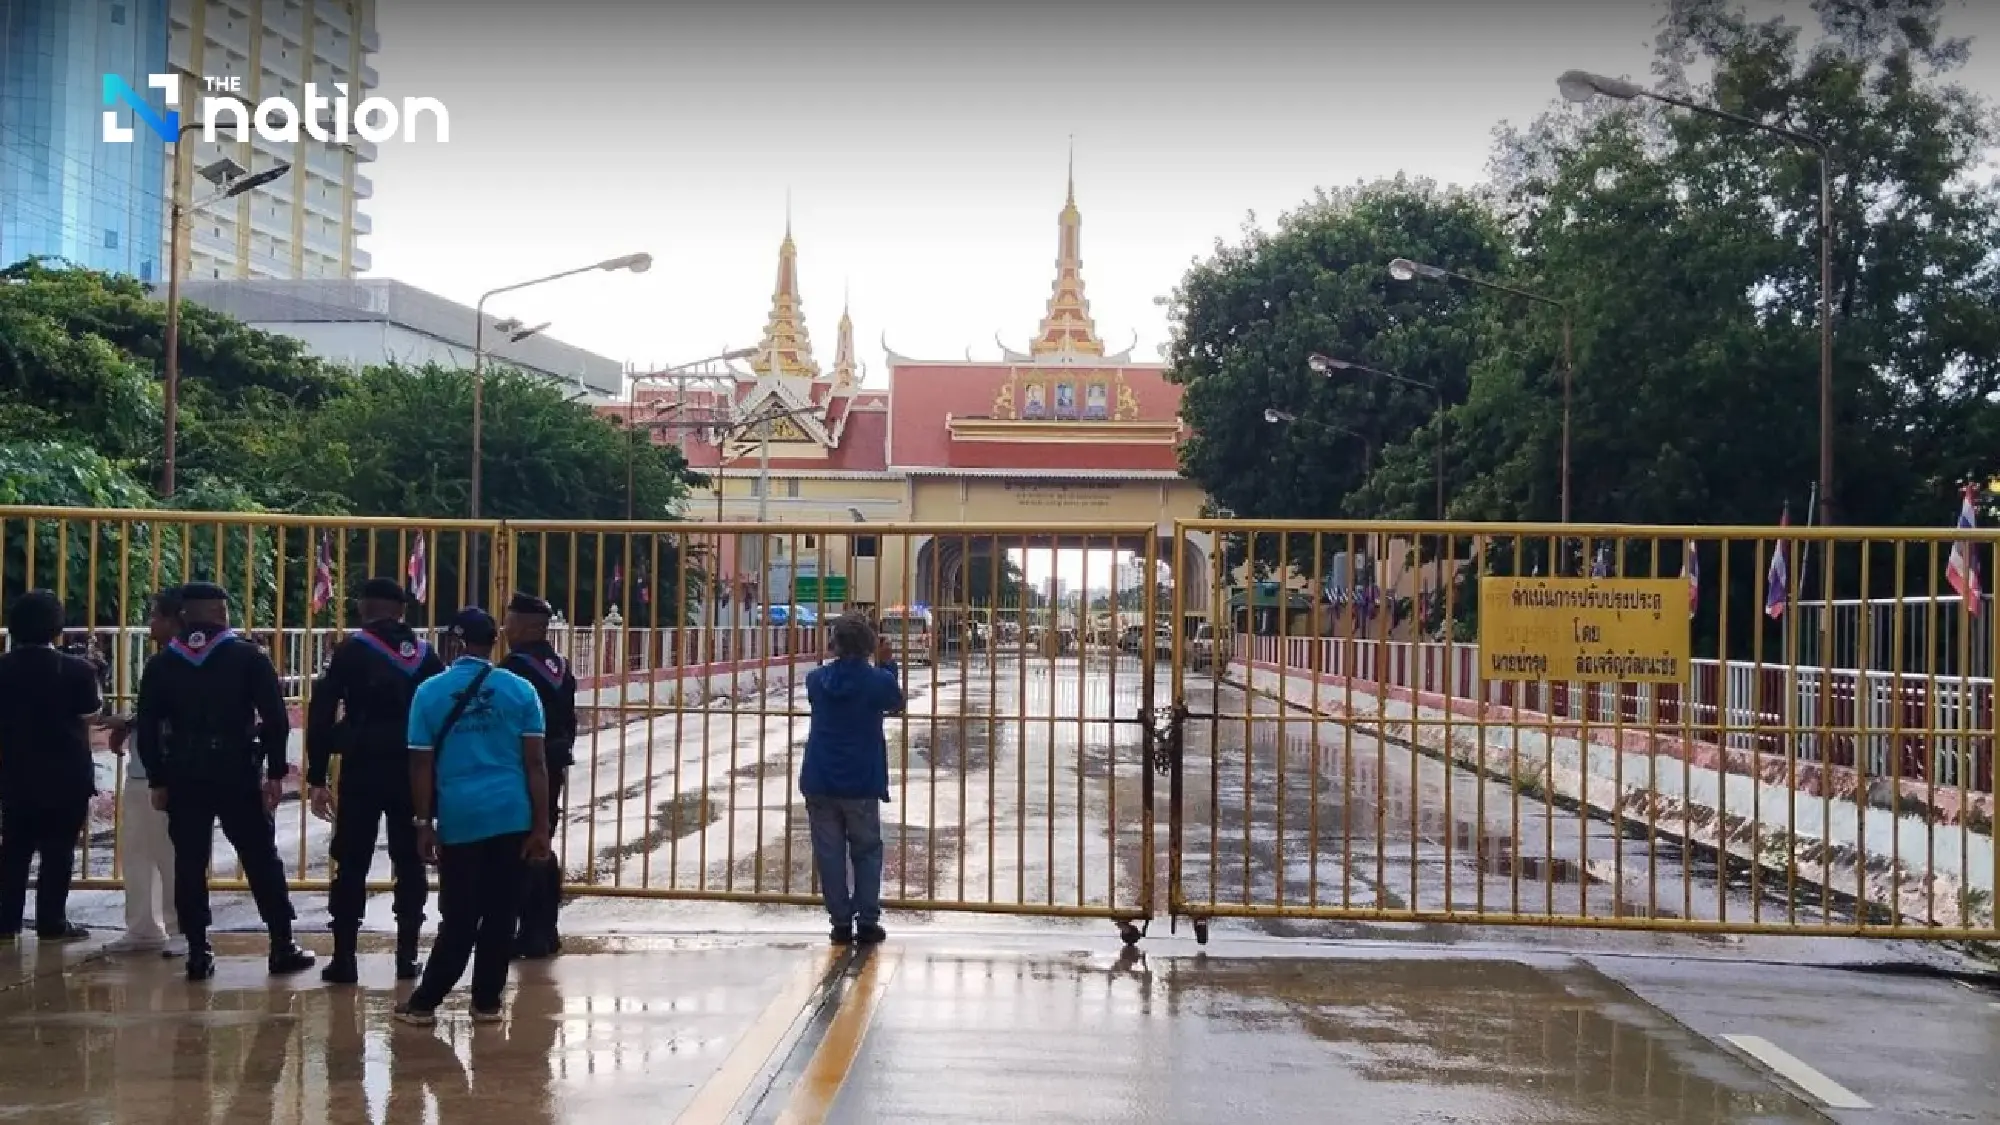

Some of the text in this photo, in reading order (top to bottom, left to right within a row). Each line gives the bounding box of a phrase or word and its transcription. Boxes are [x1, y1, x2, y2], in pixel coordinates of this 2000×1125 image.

[1511, 582, 1661, 620] ดำเนินการปรับปรุงประตู
[1574, 617, 1601, 642] โดย
